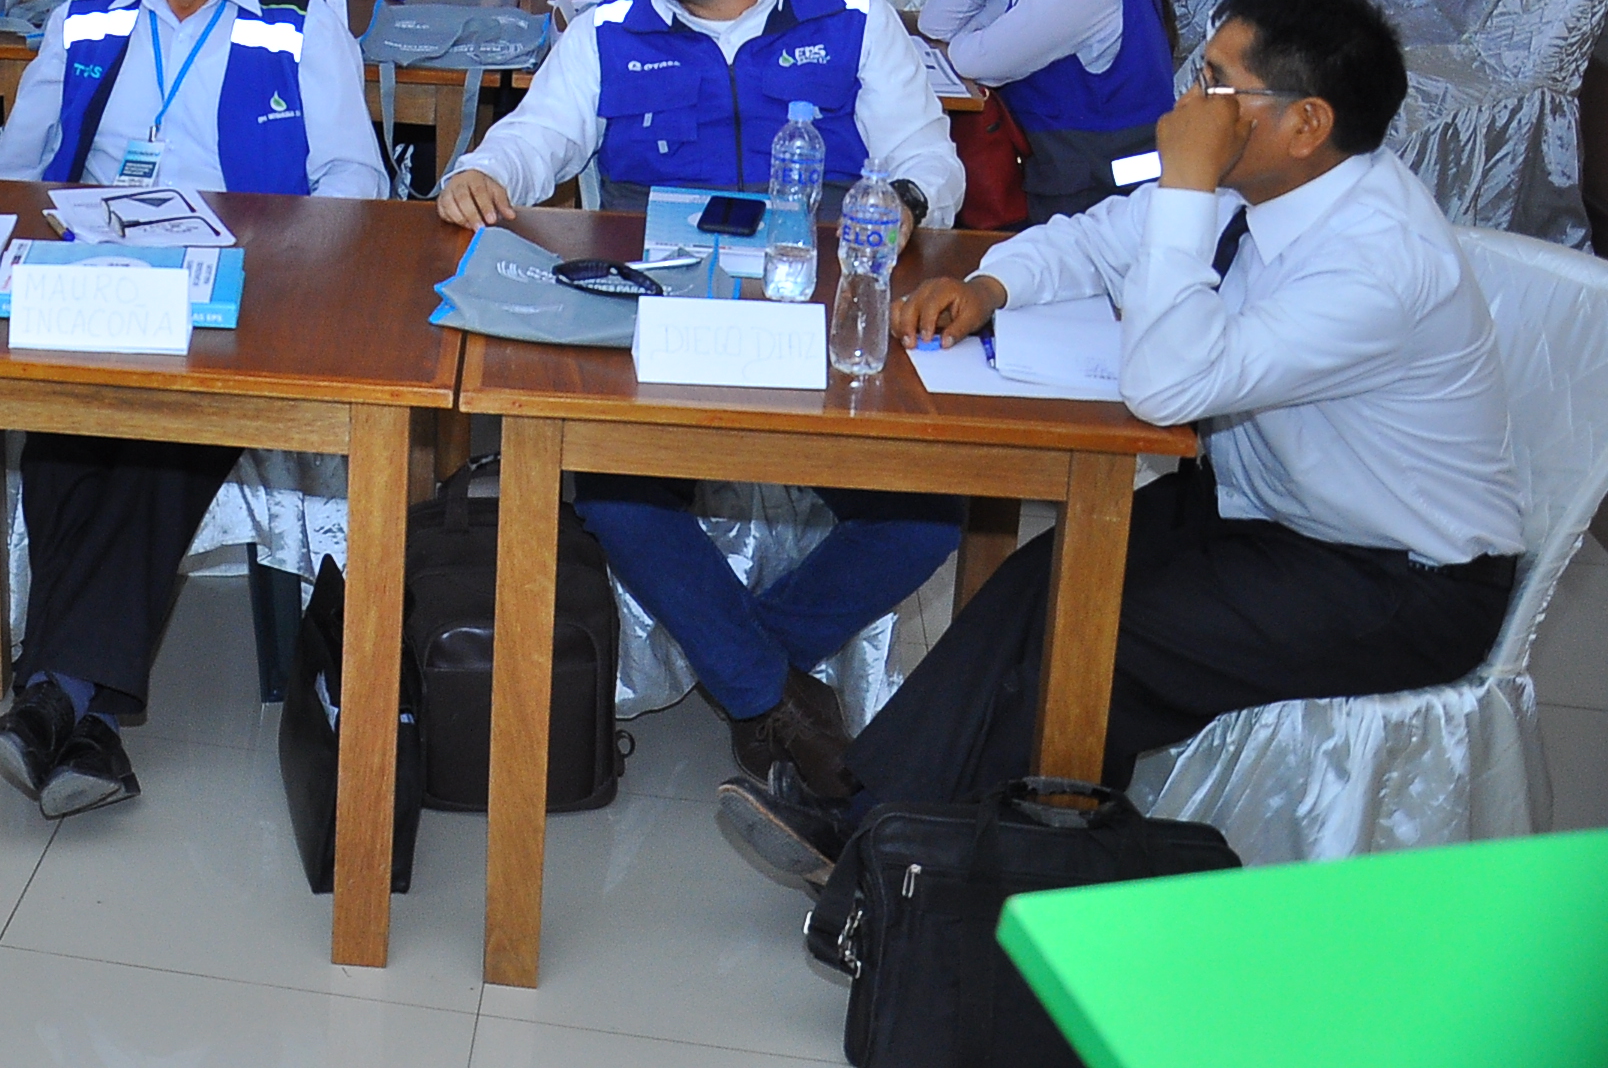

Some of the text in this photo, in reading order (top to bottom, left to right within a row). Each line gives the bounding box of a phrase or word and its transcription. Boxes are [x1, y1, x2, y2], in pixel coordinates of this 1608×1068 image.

[24, 273, 140, 305] MAURO
[650, 323, 817, 375] DIEGO DIAZ
